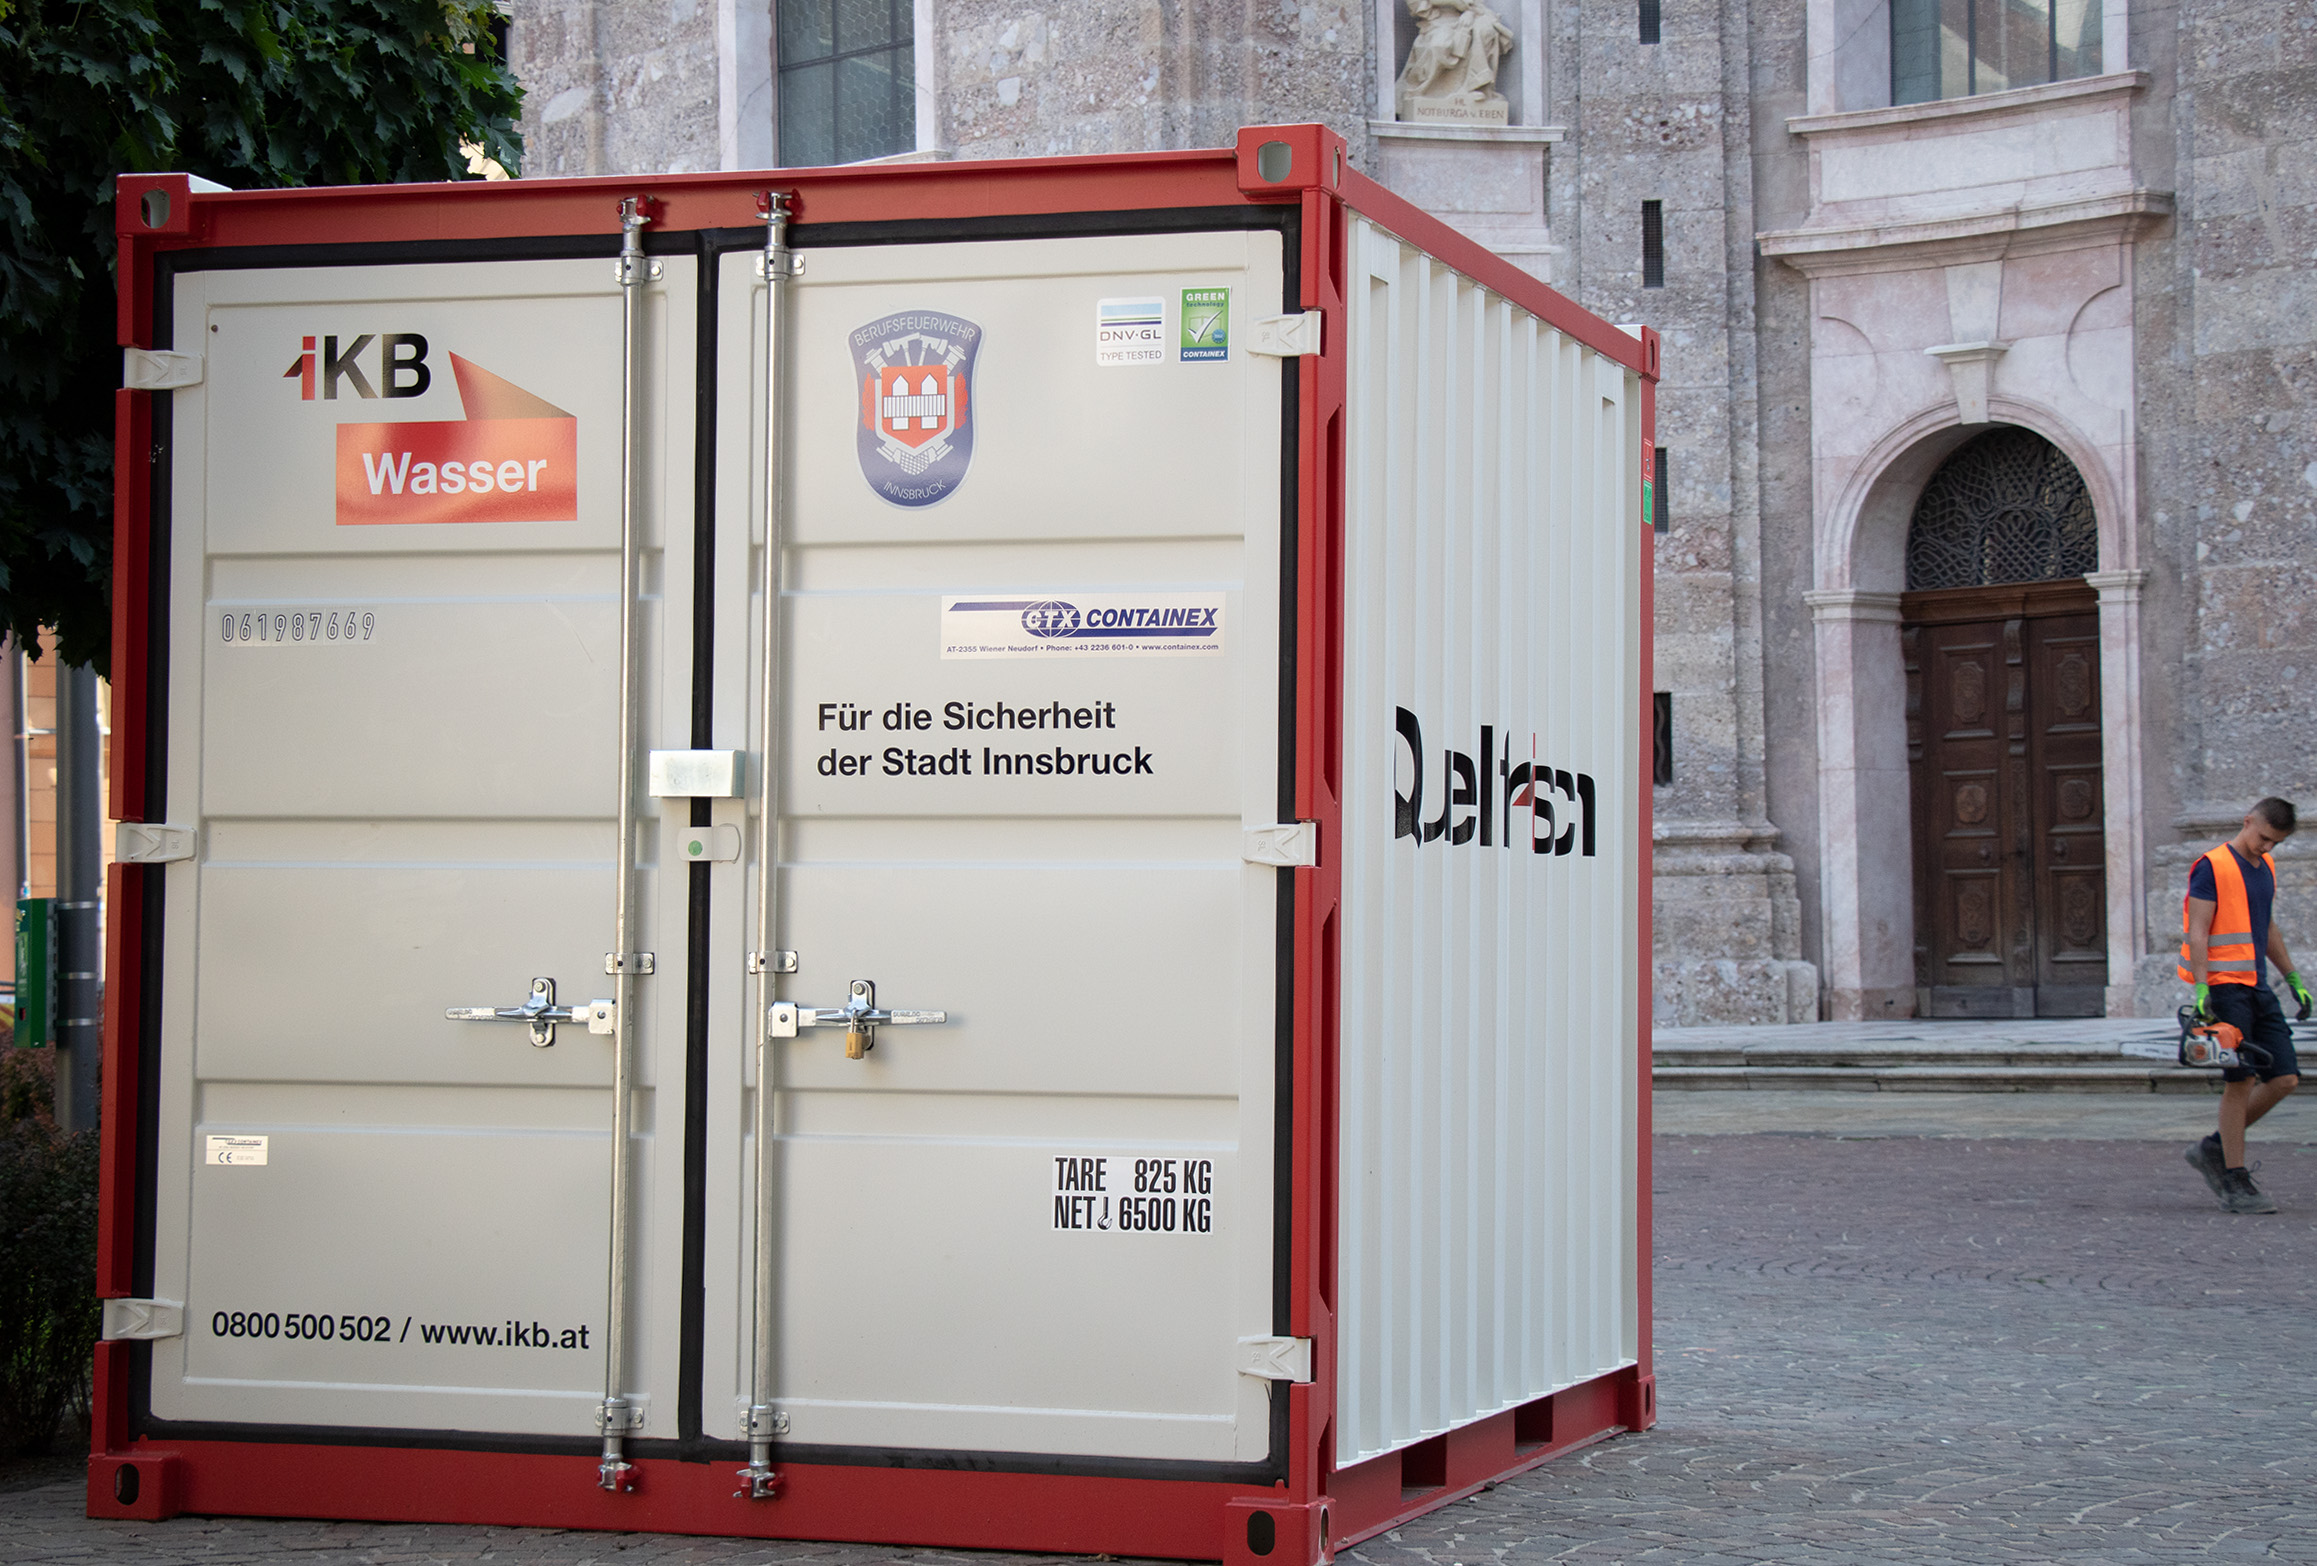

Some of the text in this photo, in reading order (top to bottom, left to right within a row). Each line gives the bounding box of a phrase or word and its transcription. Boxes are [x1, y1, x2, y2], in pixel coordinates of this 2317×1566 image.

[1416, 107, 1469, 118] NOTBURGA
[1479, 110, 1504, 119] EBEN
[1186, 292, 1225, 302] GREEN
[853, 316, 976, 347] BERUFSFEUERWEHR
[1100, 350, 1162, 361] TYPE TESTED
[1183, 349, 1225, 358] CONTAINEX
[362, 452, 547, 495] Wasser
[883, 479, 946, 500] INNSBRUCK
[221, 611, 375, 643] 061987669
[1025, 607, 1218, 629] CTX CONTAINEX
[946, 645, 977, 653] AT-2355
[1007, 644, 1038, 652] Neudorf
[1046, 644, 1072, 652] Phone:
[1112, 643, 1133, 651] 601-0
[1142, 643, 1219, 651] www.containex.com
[818, 701, 1116, 731] Für die Sicherheit
[817, 747, 1154, 776] der Stadt Innsbruck
[1055, 1157, 1212, 1195] TARE 825 KG
[1054, 1195, 1211, 1233] NET 6500 KG
[421, 1320, 590, 1349] www.ikb.at
